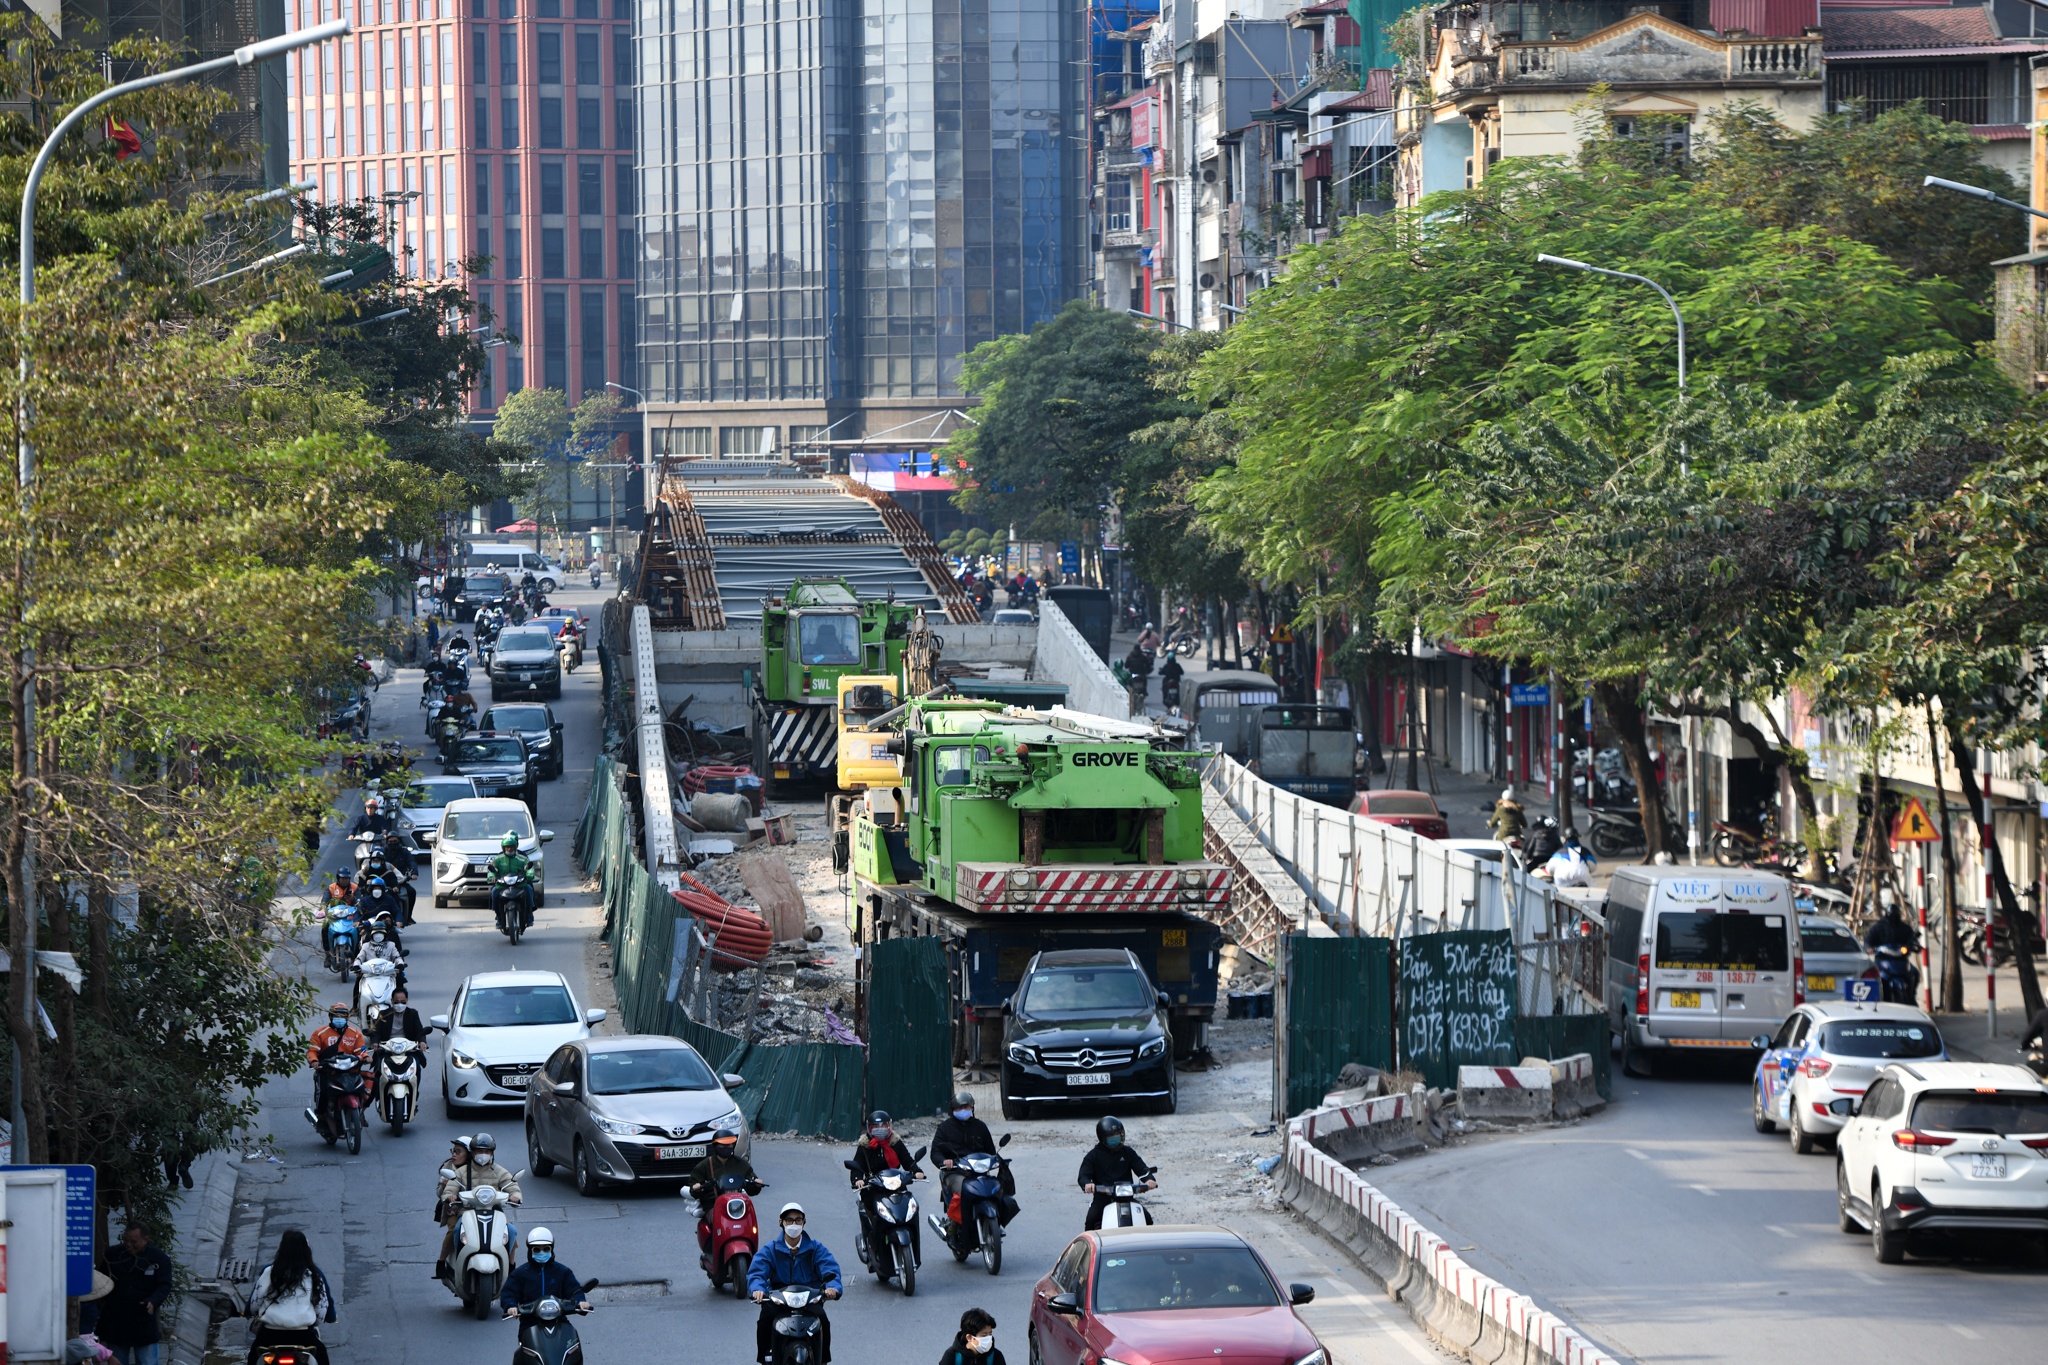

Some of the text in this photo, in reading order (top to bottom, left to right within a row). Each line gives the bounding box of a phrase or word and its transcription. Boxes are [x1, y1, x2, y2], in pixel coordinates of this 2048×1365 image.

[812, 678, 831, 690] SWL
[1072, 752, 1138, 766] GROVE
[1673, 880, 1710, 897] VIỆT
[1696, 972, 1714, 983] 29B
[1726, 972, 1756, 984] 138.77
[661, 1148, 704, 1158] 34A-387.39
[1974, 1166, 2004, 1177] 772.19
